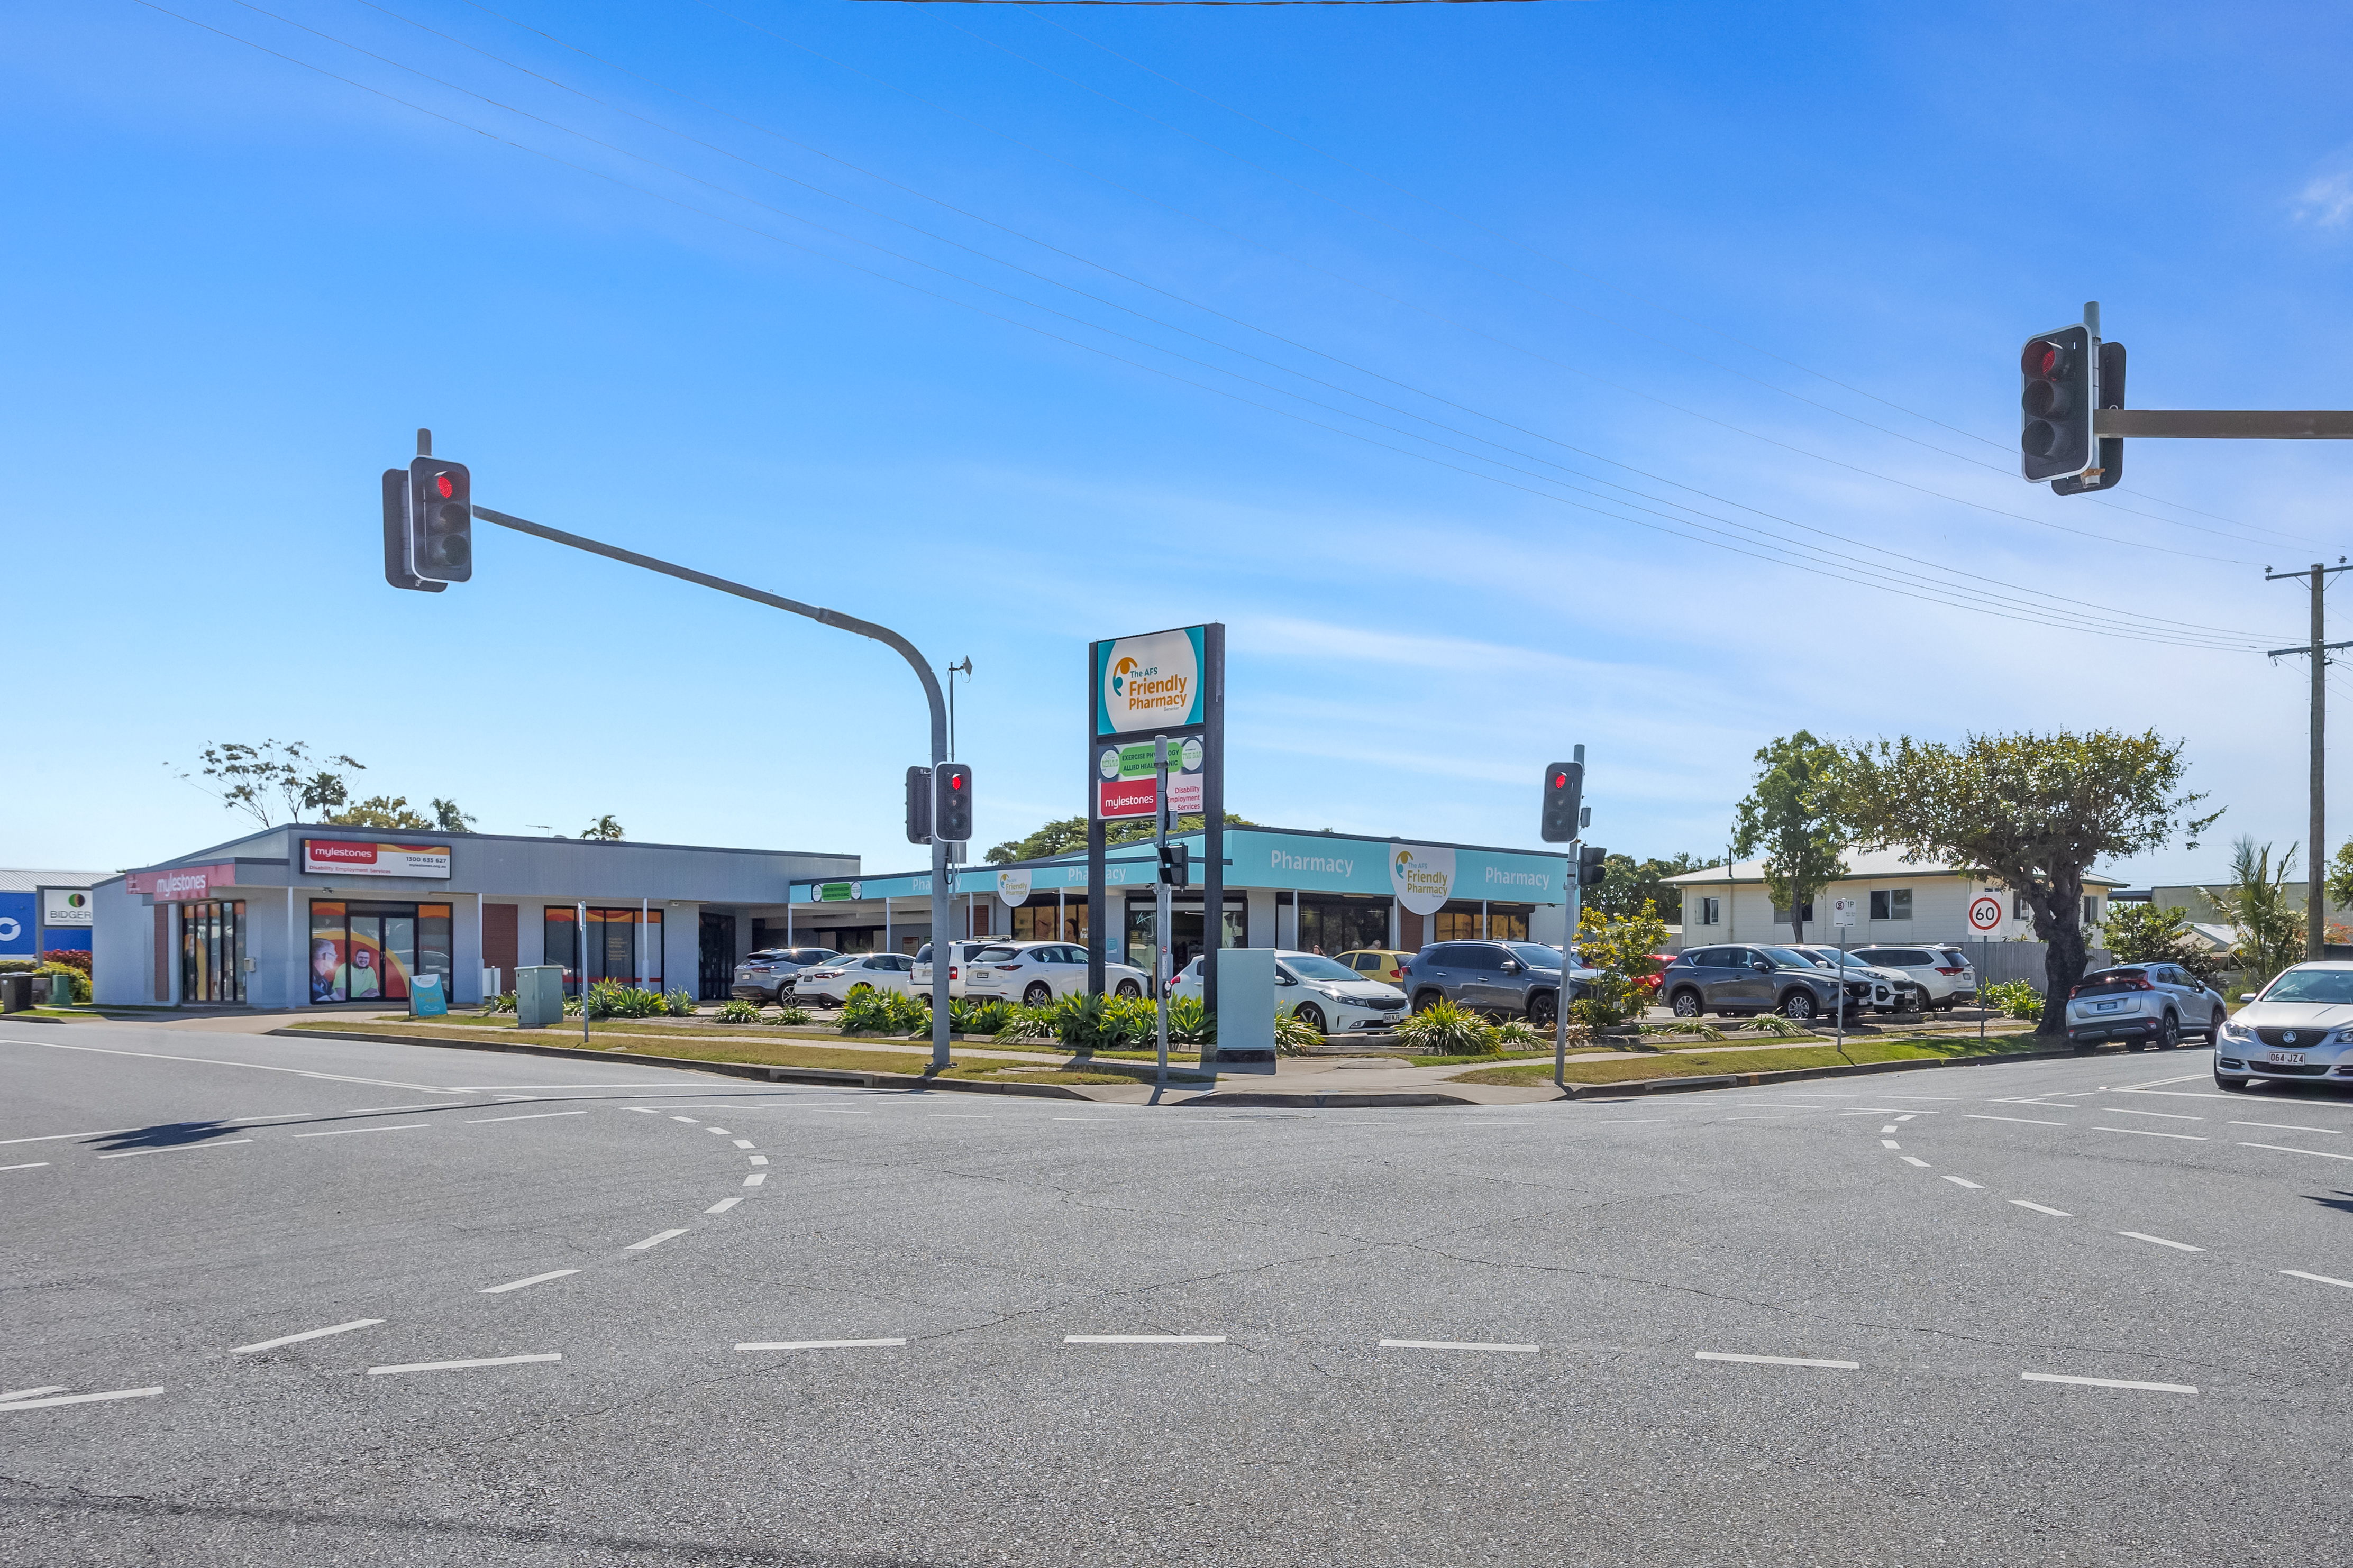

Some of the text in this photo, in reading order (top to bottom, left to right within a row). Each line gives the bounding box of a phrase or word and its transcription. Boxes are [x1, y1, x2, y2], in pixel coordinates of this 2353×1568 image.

[1144, 667, 1158, 676] AFS
[1129, 674, 1187, 696] Friendly
[1129, 694, 1187, 710] Pharmacy
[1105, 795, 1154, 809] mylestones
[1167, 794, 1200, 803] Employment
[315, 847, 372, 858] mylestones
[1271, 850, 1354, 878] Pharmacy
[1069, 867, 1126, 882] Phaacy
[1407, 869, 1448, 886] Friendly
[1485, 867, 1550, 891] Pharmacy
[156, 873, 206, 897] mylestones
[1006, 882, 1027, 891] Friendly
[1407, 883, 1448, 896] Pharmacy
[1976, 907, 1995, 921] 60
